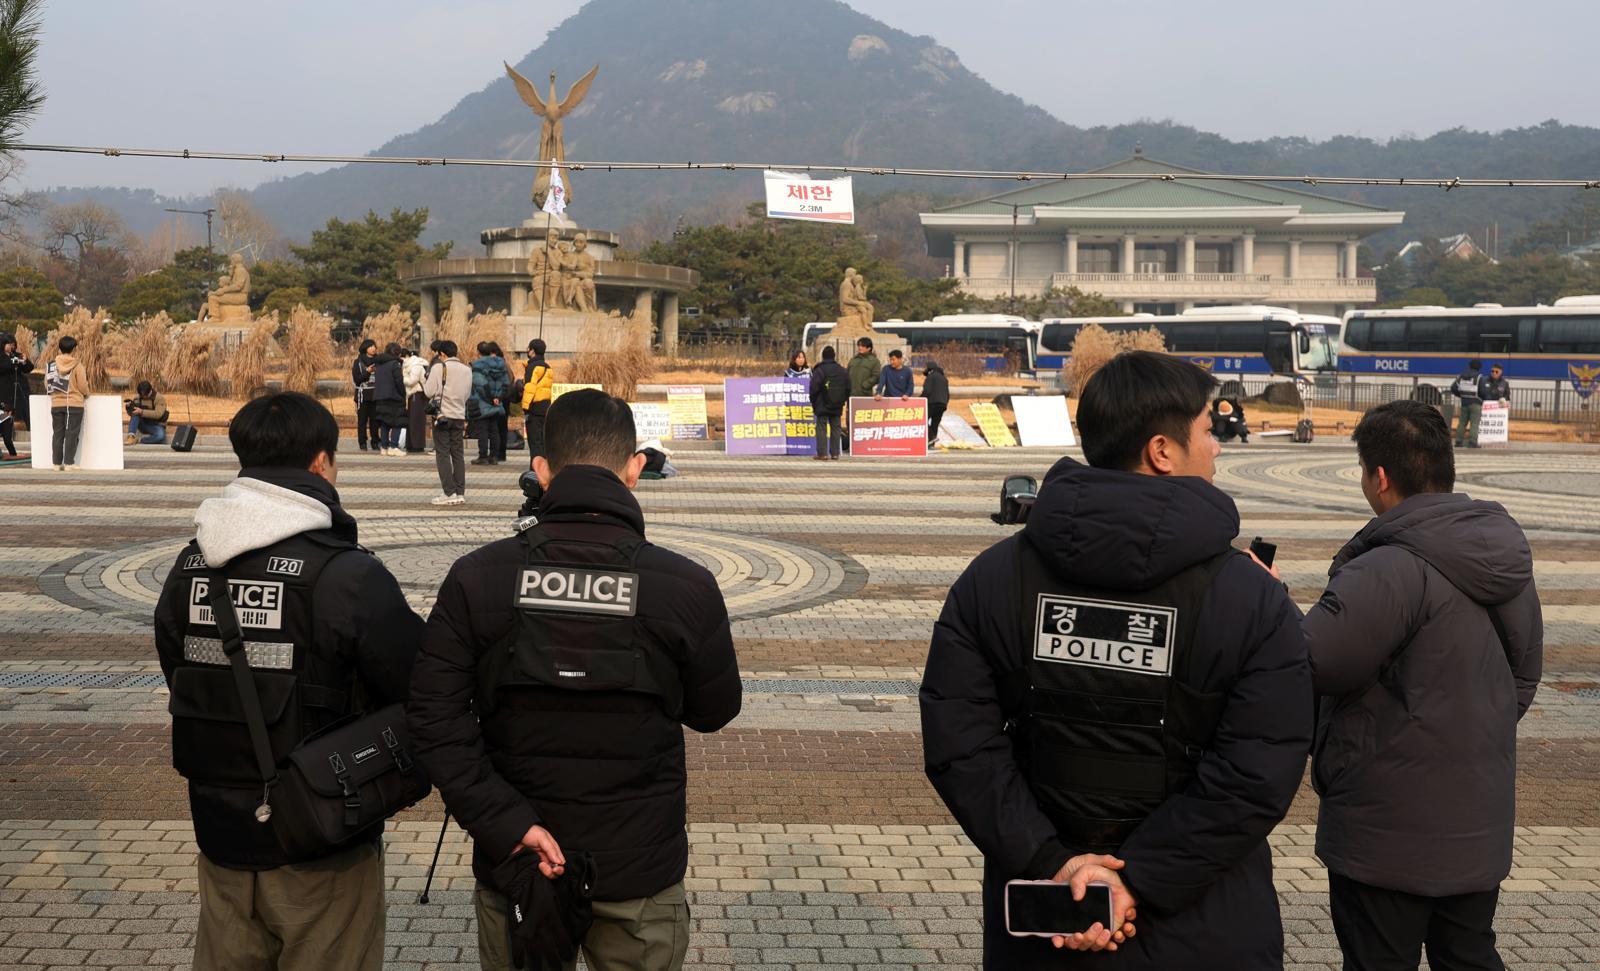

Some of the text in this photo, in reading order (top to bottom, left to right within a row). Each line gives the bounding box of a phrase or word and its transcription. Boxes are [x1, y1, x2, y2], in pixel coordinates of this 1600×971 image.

[787, 184, 833, 201] 제한
[800, 204, 823, 213] 2.3M
[1376, 359, 1409, 371] POLICE
[753, 405, 815, 421] 세종호텔은
[884, 406, 924, 422] 고용승계
[732, 422, 783, 439] 정리해고
[853, 426, 883, 442] 정부가
[272, 558, 298, 573] 120
[520, 569, 634, 604] POLICE
[194, 582, 277, 609] PICE
[1050, 636, 1154, 668] POLICE
